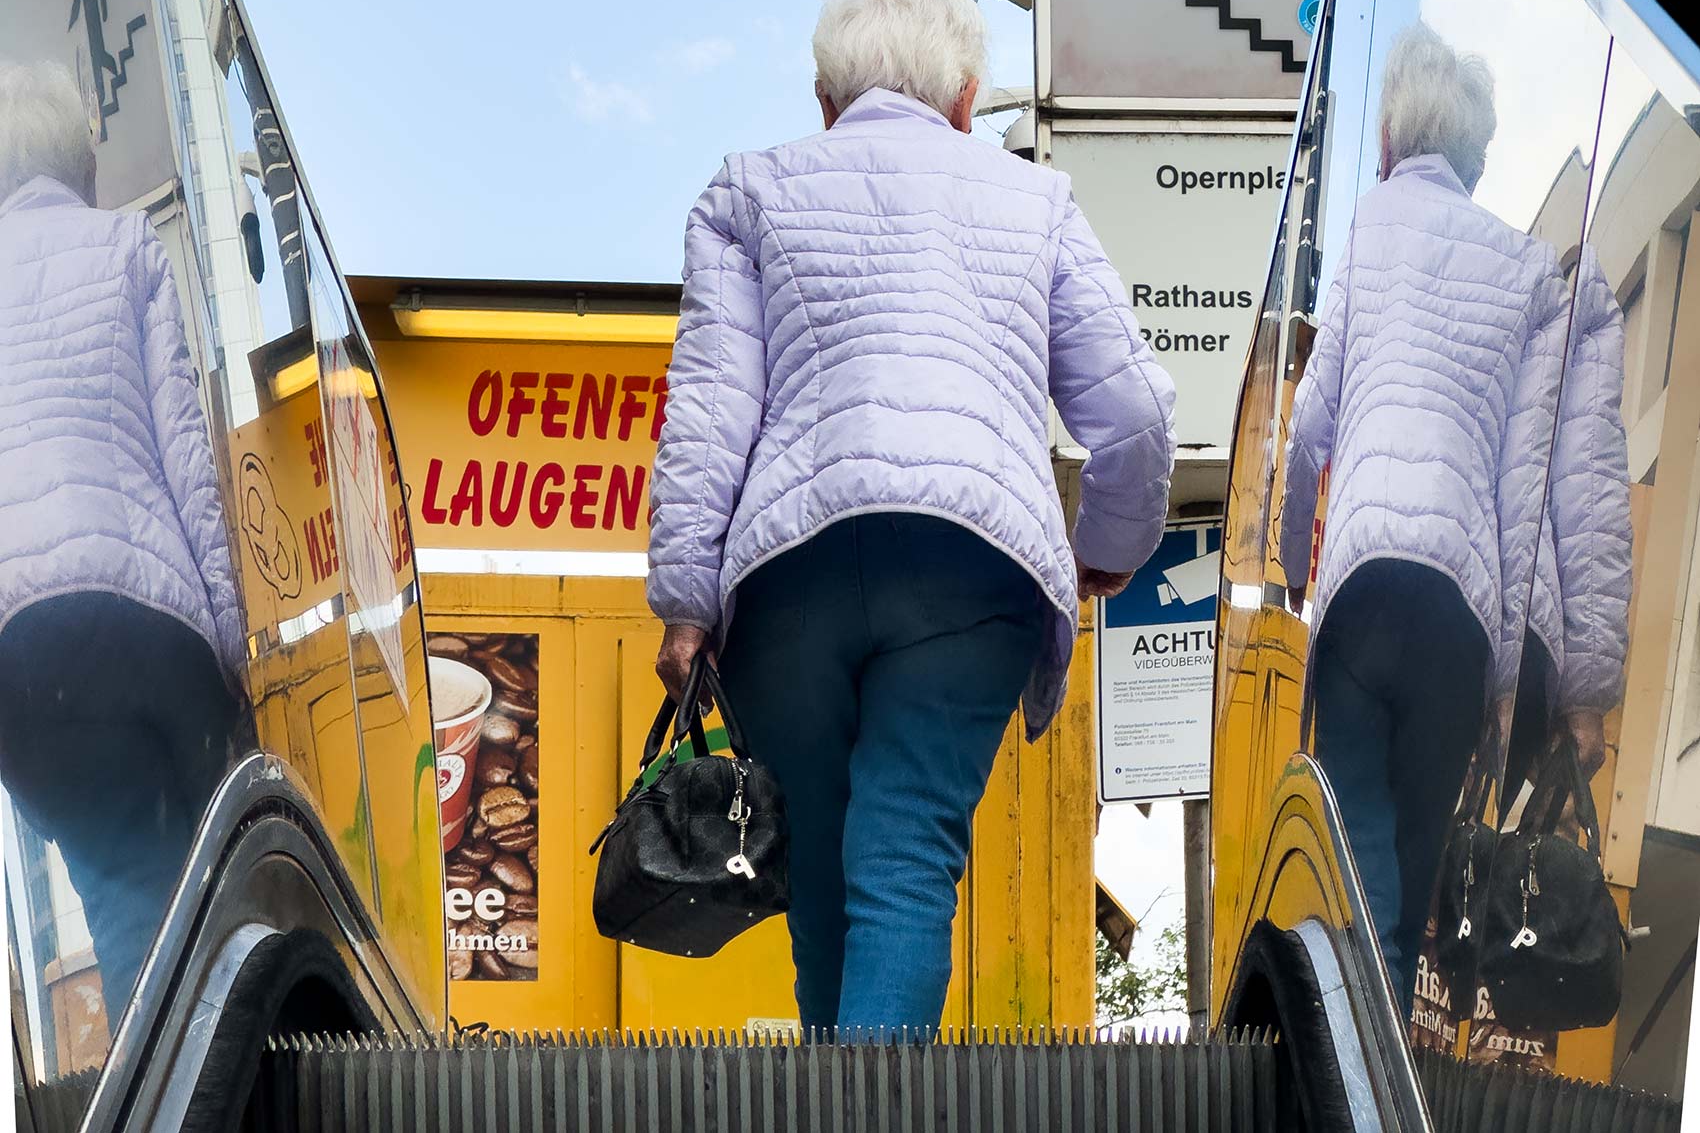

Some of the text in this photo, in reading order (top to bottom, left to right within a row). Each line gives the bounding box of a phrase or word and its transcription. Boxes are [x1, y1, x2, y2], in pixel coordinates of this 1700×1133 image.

[1132, 284, 1252, 308] Rathaus
[421, 459, 652, 531] LAUGEN
[446, 887, 505, 921] ee
[448, 929, 528, 952] hmen
